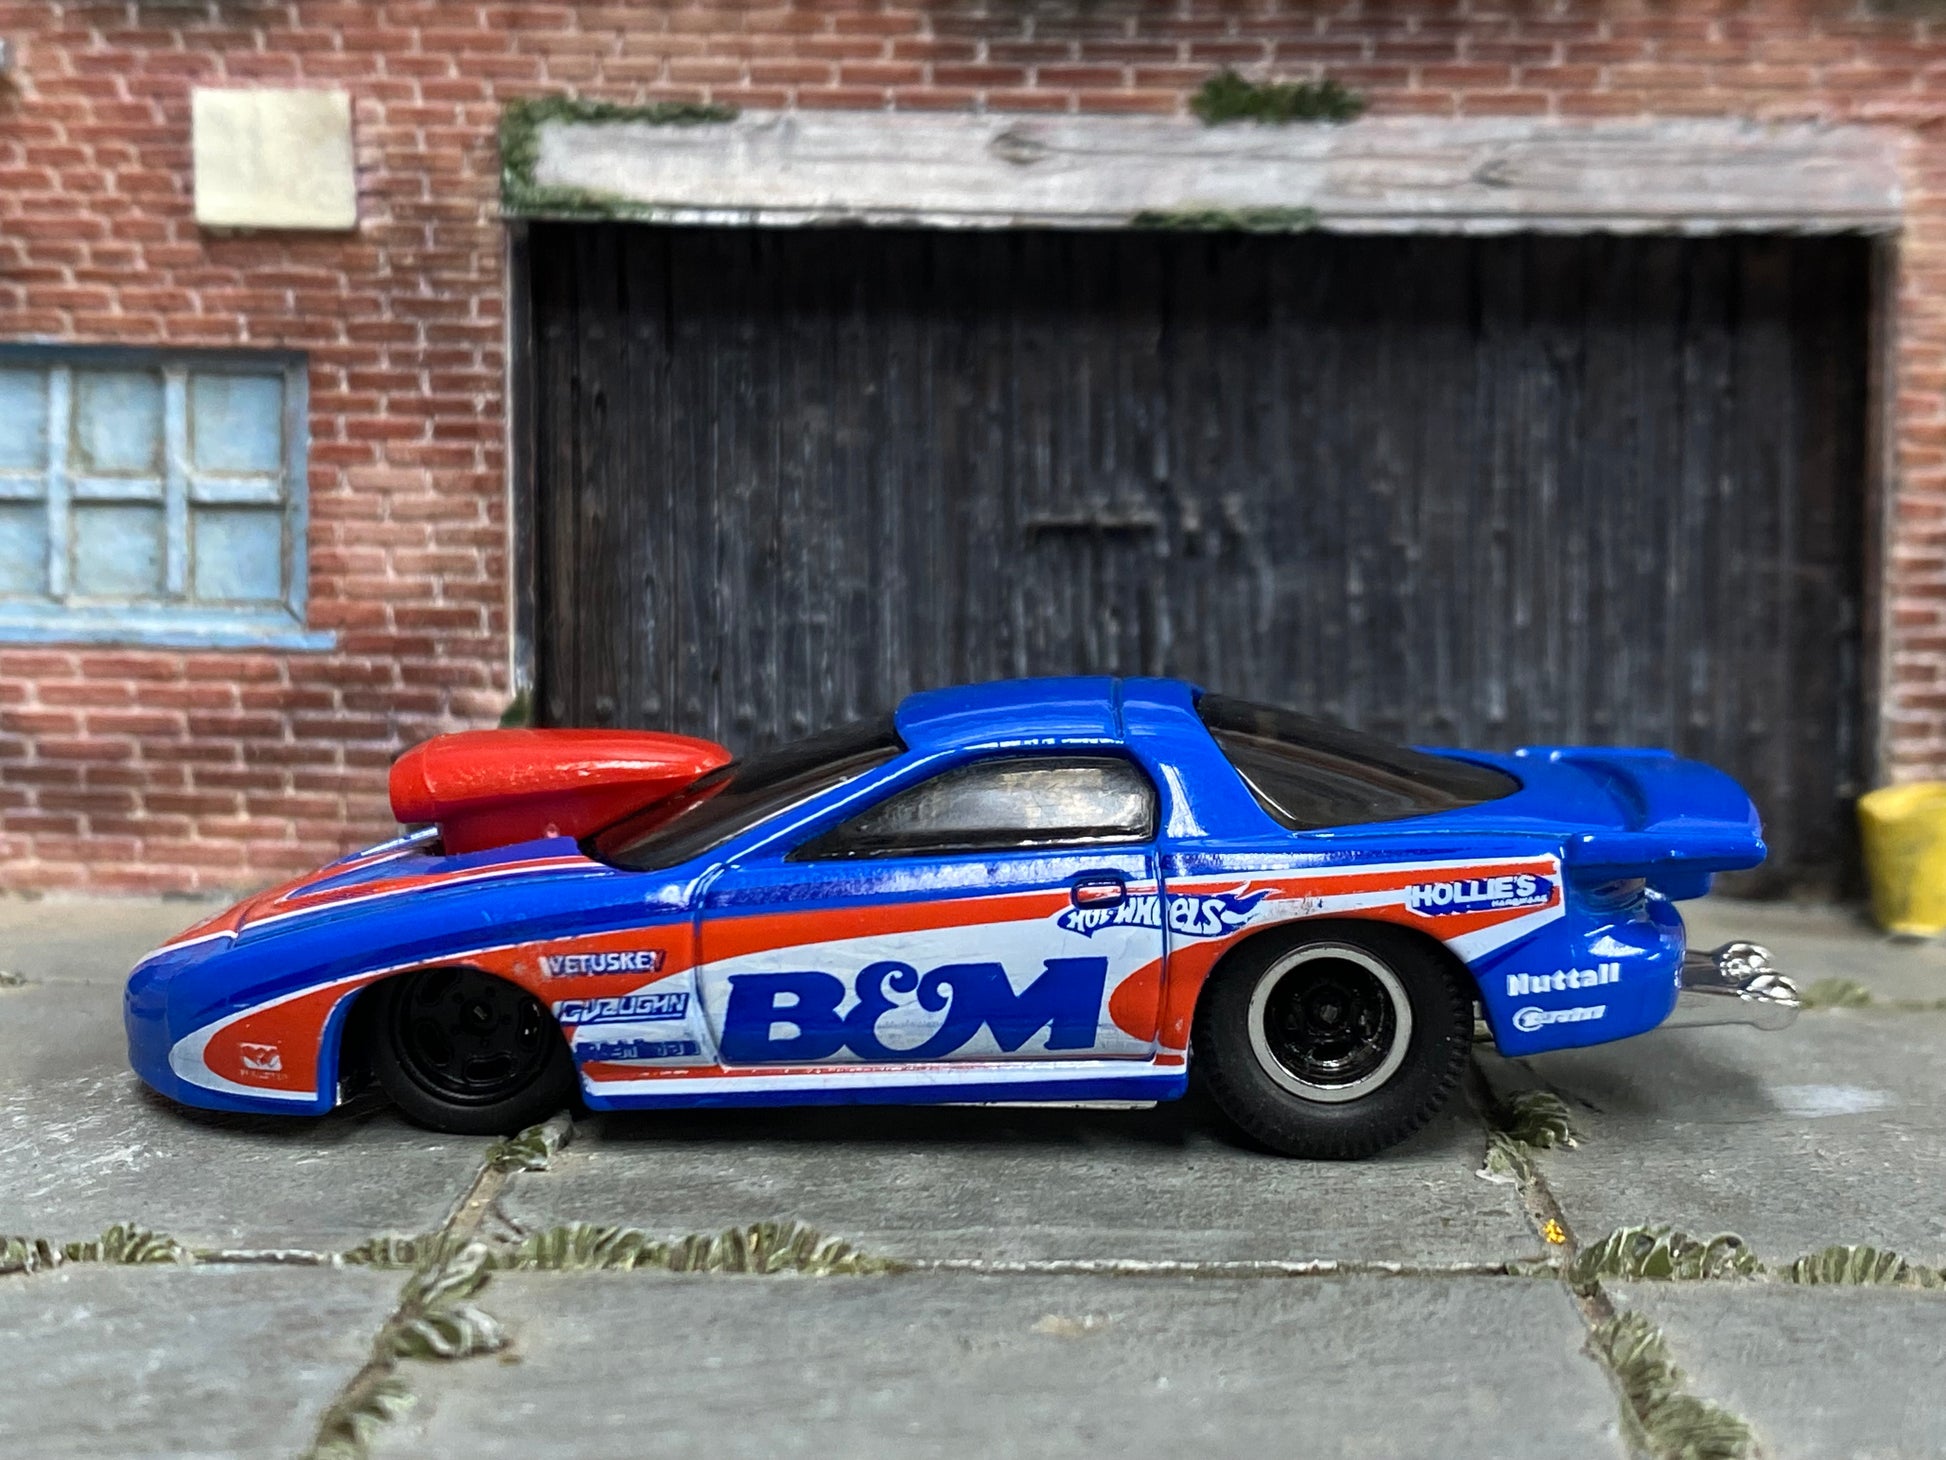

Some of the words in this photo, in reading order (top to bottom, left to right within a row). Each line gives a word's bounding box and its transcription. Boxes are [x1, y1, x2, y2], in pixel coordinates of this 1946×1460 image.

[1411, 874, 1537, 907] HOLLIE'S
[1506, 962, 1620, 996] Nuttall
[721, 956, 1109, 1062] B&M
